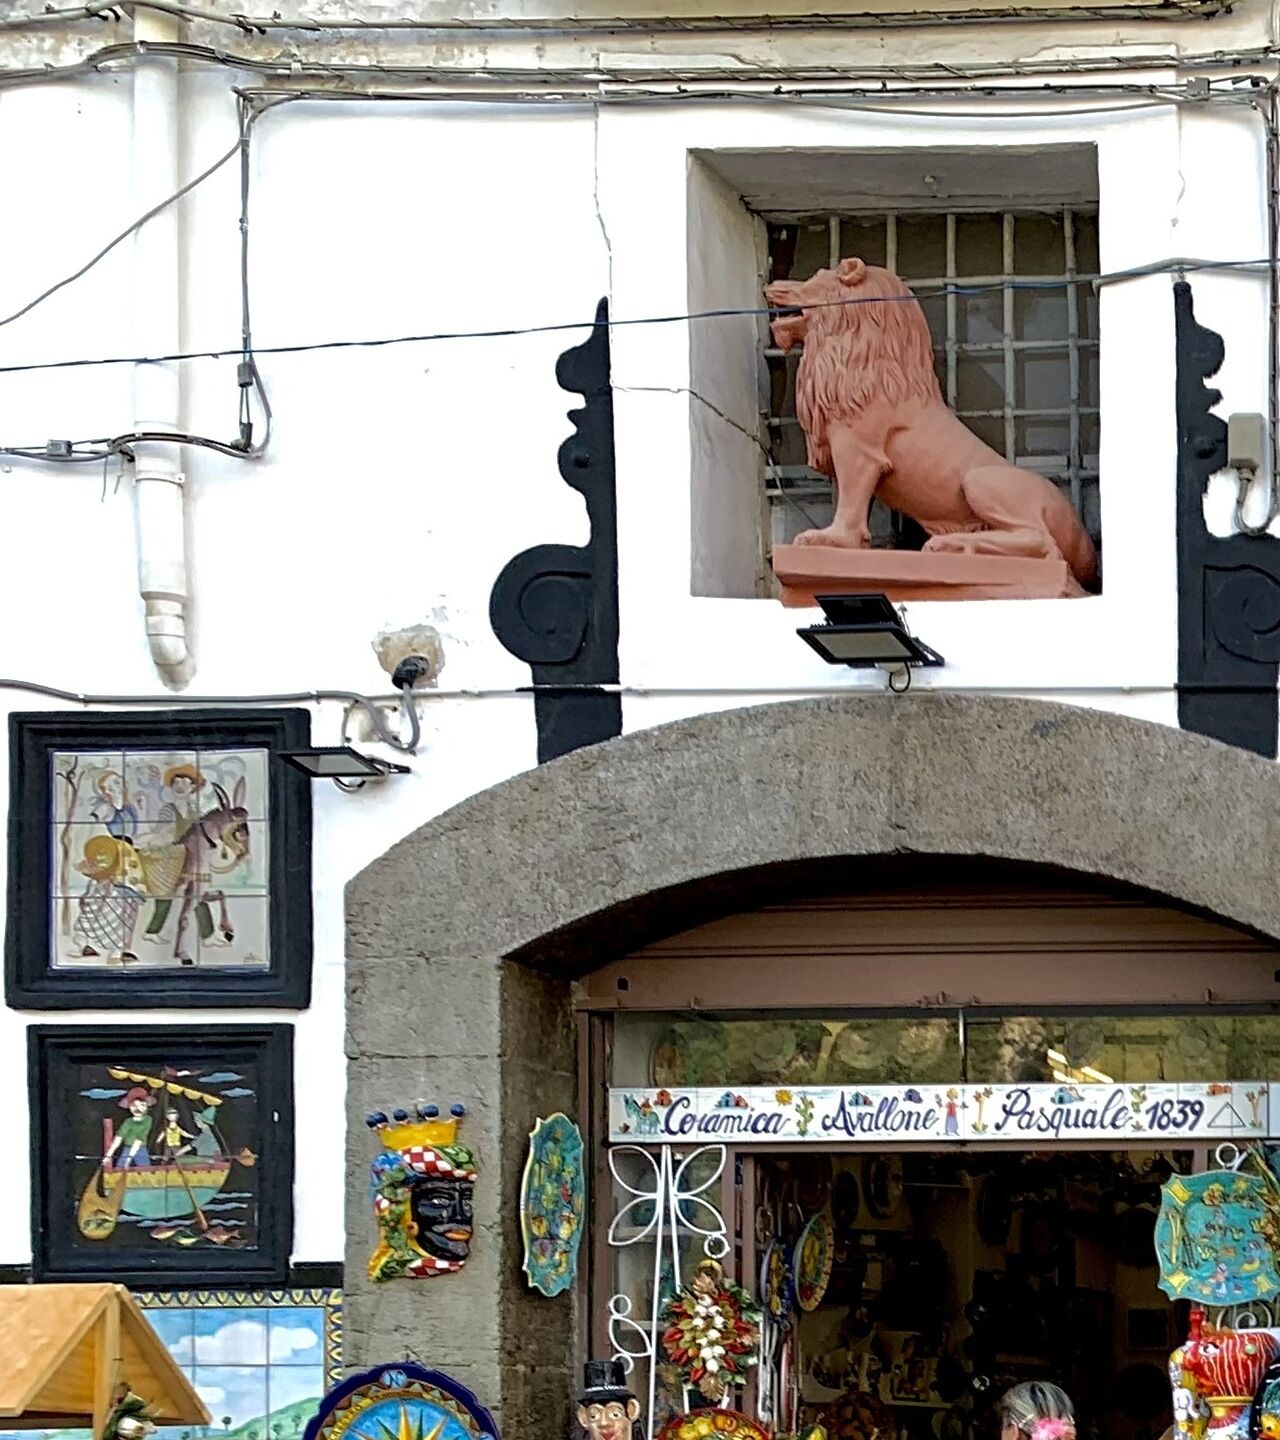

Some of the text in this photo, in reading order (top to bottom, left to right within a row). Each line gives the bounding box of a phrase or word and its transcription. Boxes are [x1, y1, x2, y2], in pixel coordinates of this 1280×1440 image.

[820, 1089, 940, 1135] Avallone
[994, 1087, 1132, 1138] Pasquale
[1144, 1100, 1205, 1131] 1839
